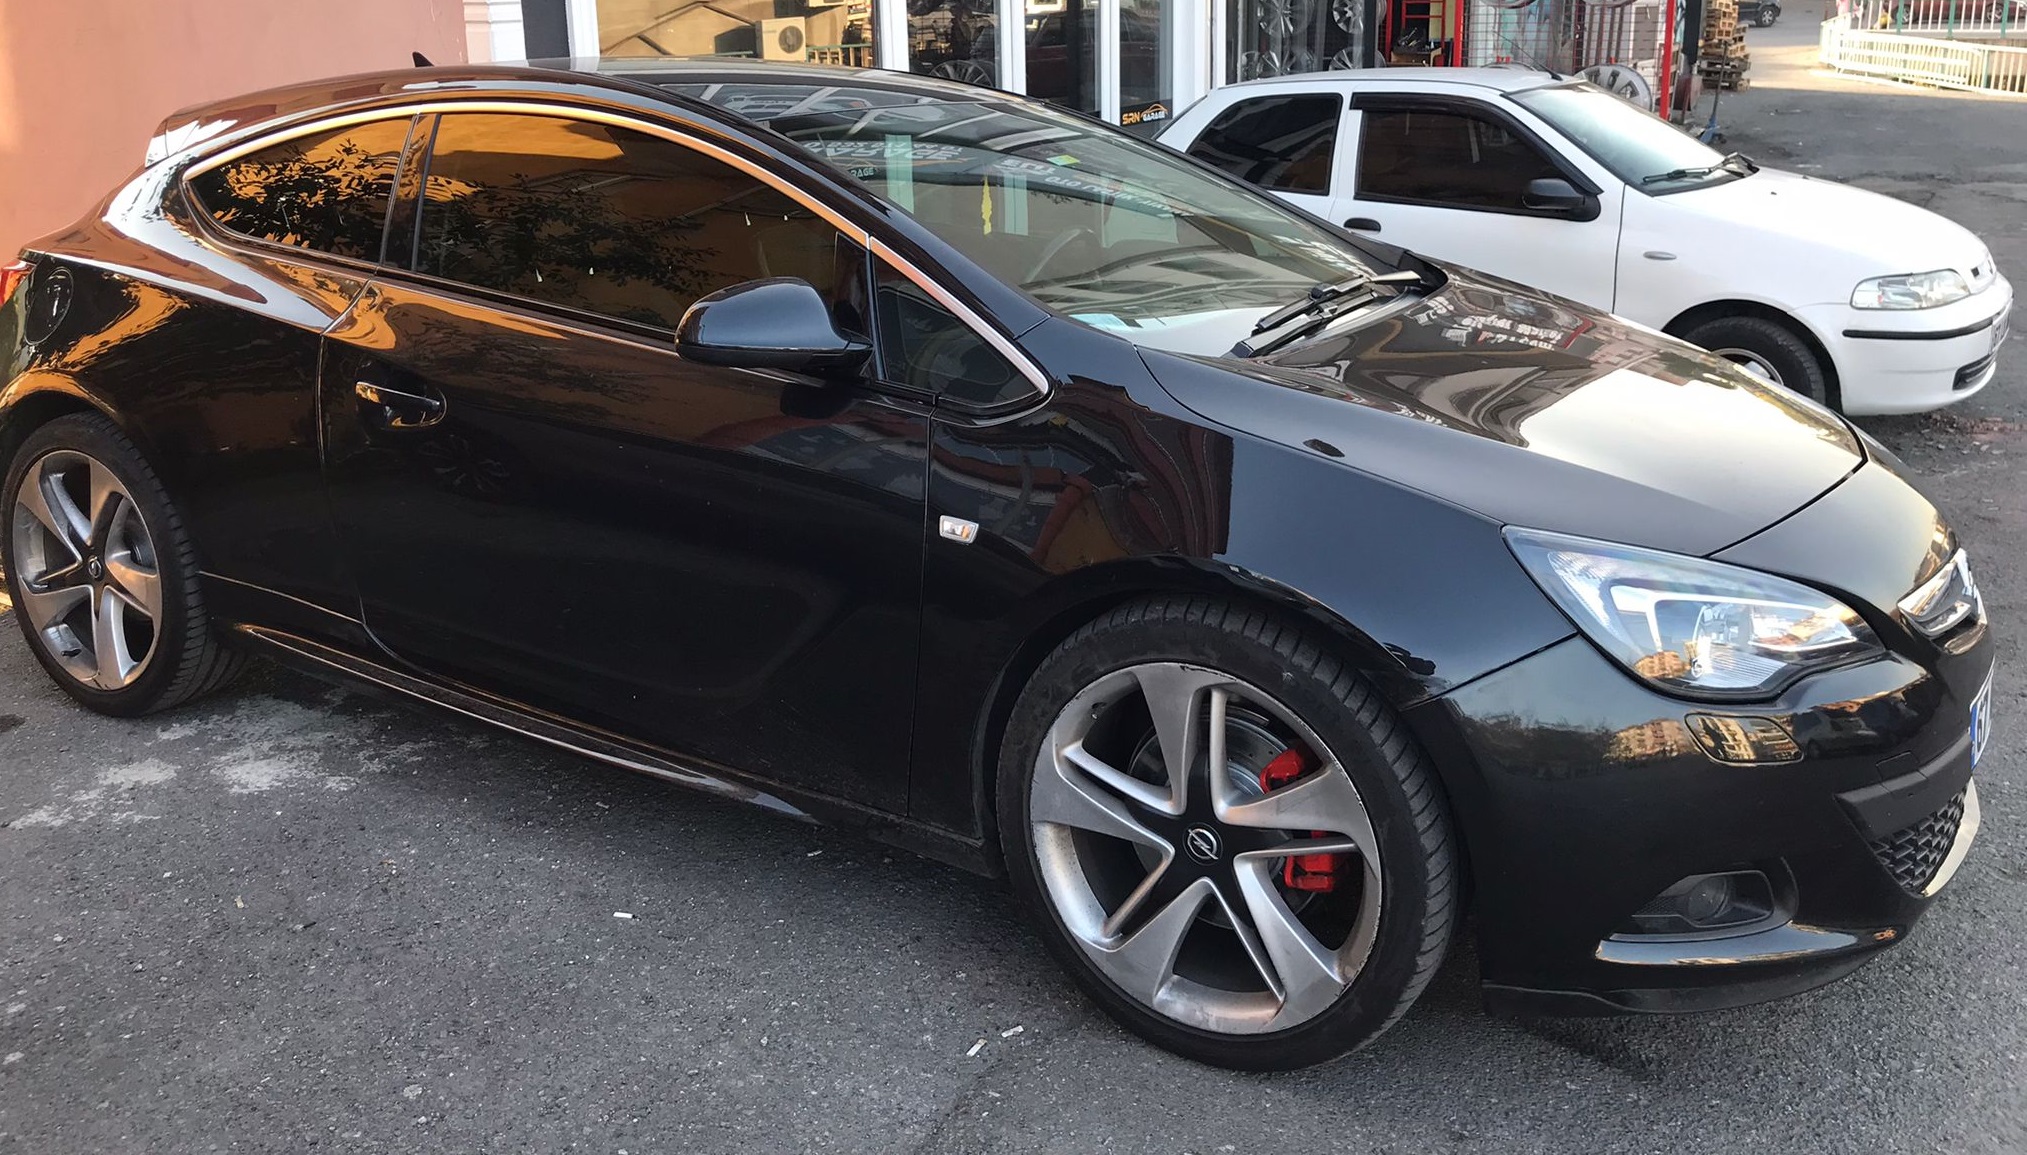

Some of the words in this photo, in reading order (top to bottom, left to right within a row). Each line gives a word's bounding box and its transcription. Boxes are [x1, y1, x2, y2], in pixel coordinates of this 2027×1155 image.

[1122, 111, 1140, 125] SRN
[1142, 110, 1166, 121] GARAGE
[849, 167, 874, 178] RAGE
